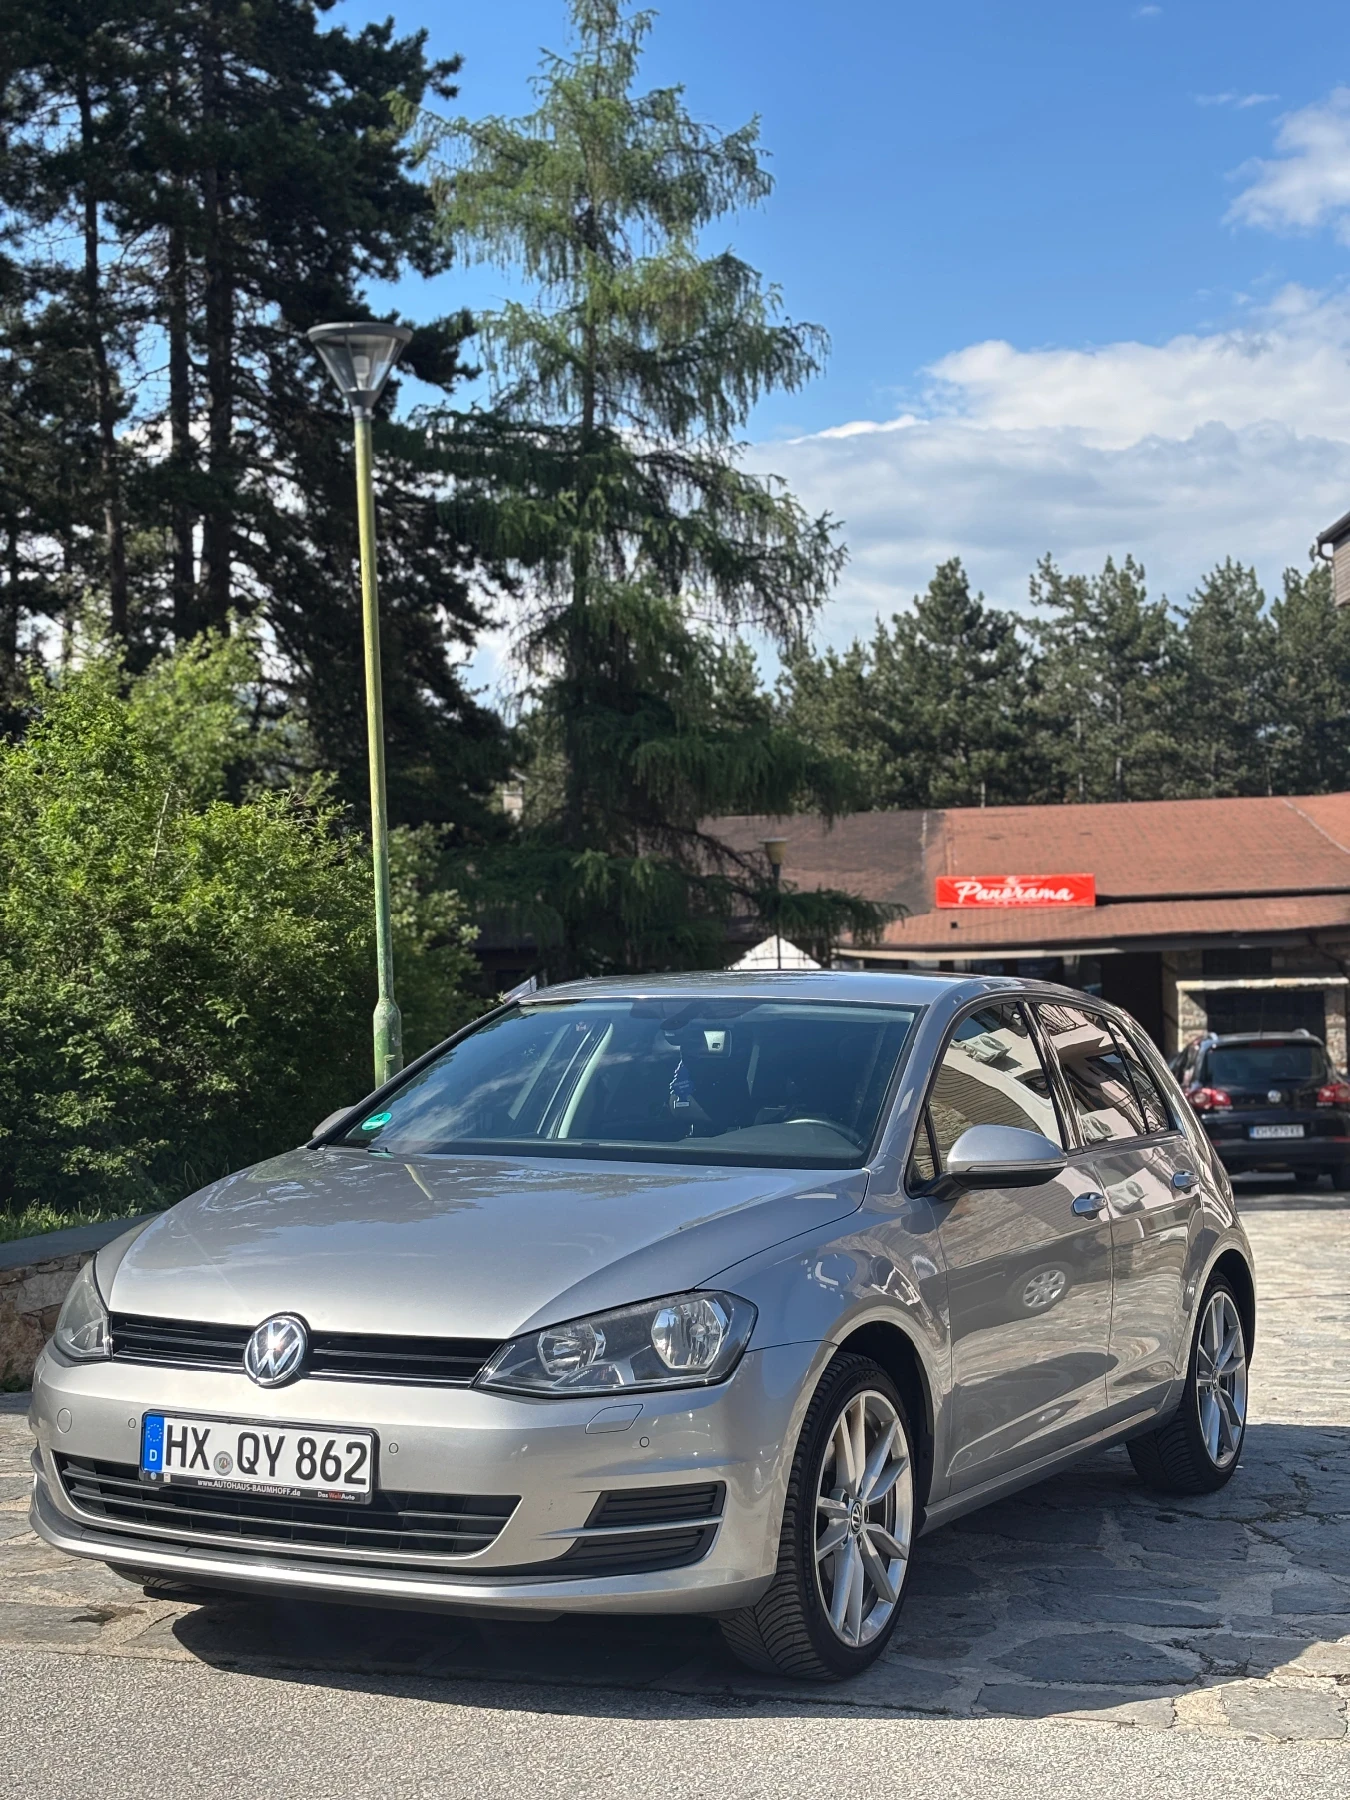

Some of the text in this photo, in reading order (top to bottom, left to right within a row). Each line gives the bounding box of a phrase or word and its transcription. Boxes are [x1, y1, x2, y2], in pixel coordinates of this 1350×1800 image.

[954, 881, 1074, 904] Panorama
[149, 1449, 158, 1462] D
[165, 1424, 367, 1485] HX QY 862
[197, 1479, 301, 1497] www.AUTOHAUS-BAUMHOFF.de
